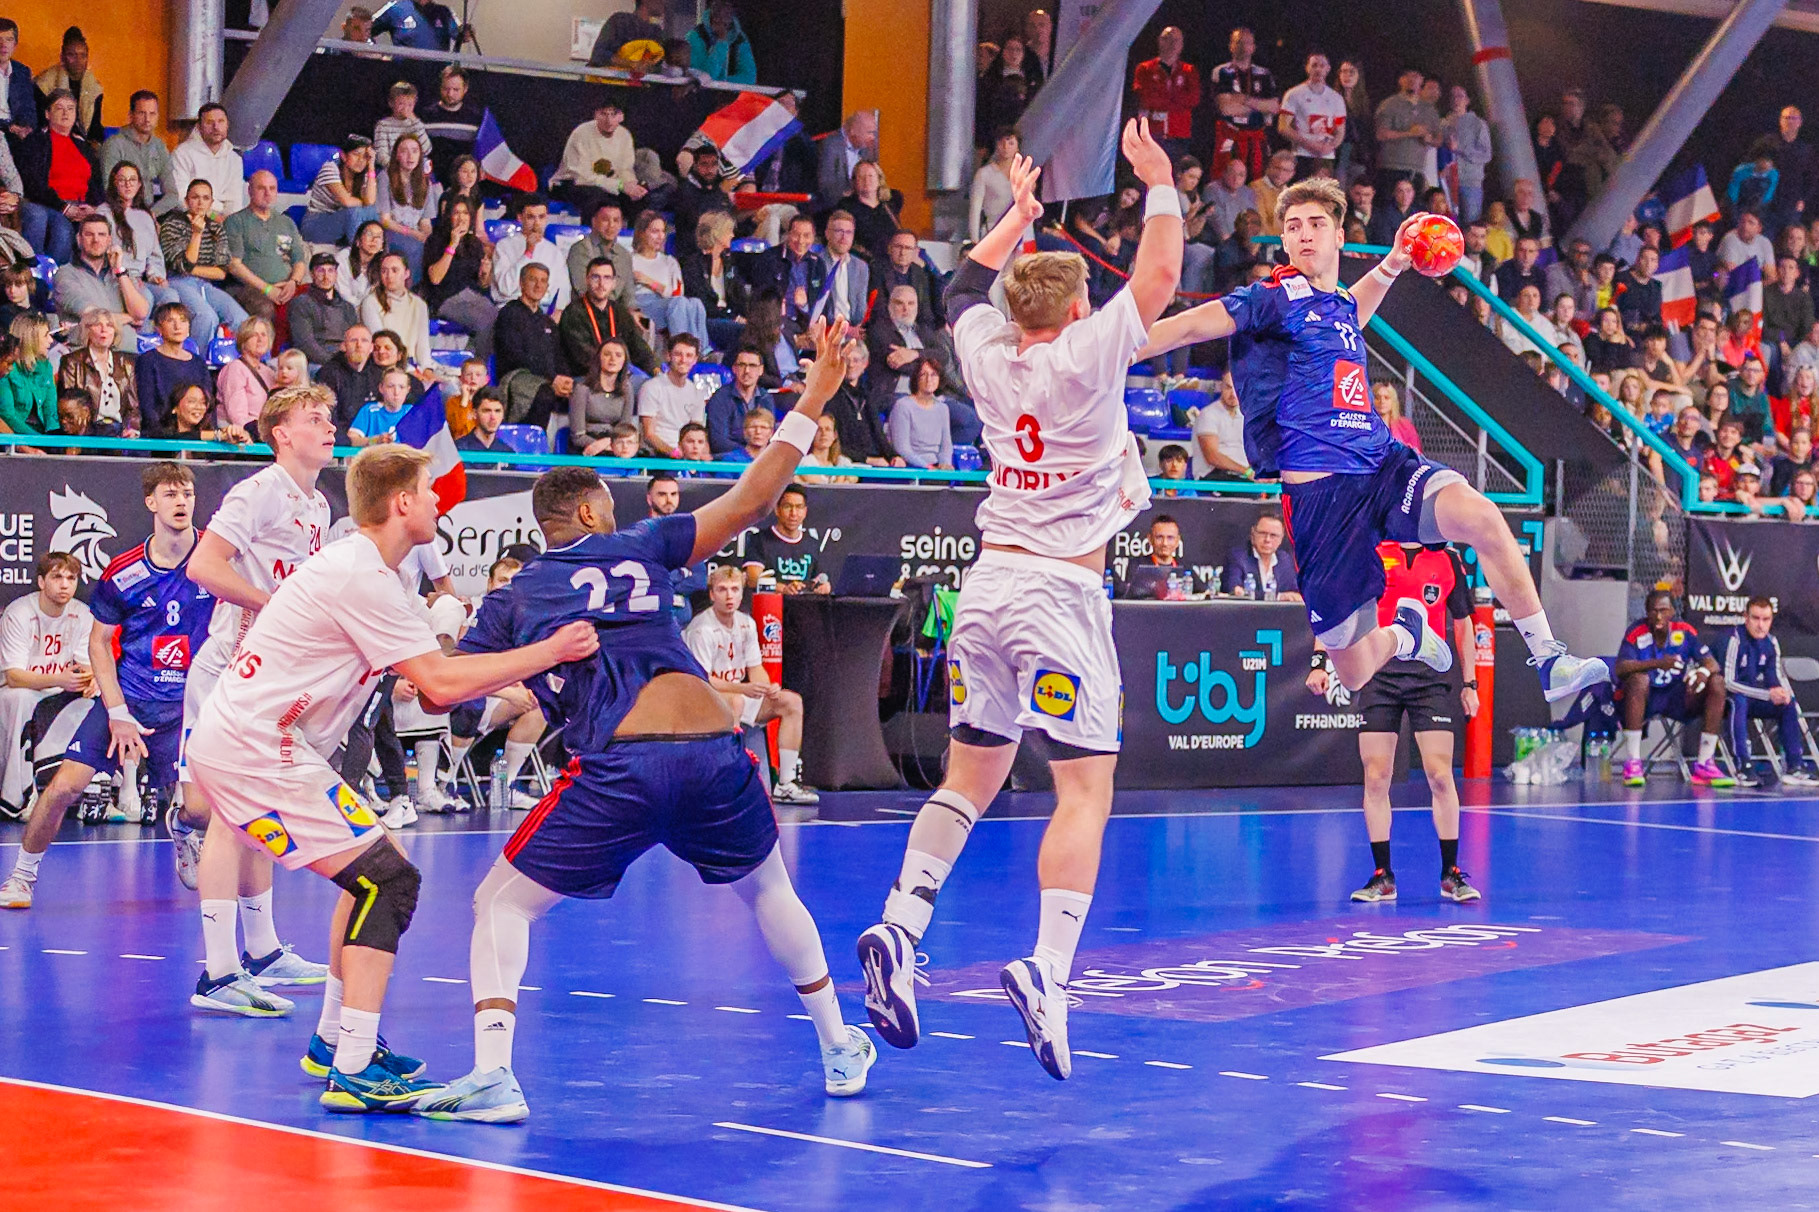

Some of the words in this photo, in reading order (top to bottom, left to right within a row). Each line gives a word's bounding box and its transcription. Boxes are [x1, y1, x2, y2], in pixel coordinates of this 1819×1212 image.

[1015, 414, 1044, 463] 3
[1401, 464, 1432, 515] ACADOMIA
[900, 525, 976, 560] seine
[569, 560, 661, 614] 22
[166, 600, 181, 627] 8
[45, 634, 62, 656] 25
[1168, 735, 1190, 750] VAL
[1191, 734, 1245, 750] D'EUROPE
[1559, 1023, 1801, 1065] Butagaz
